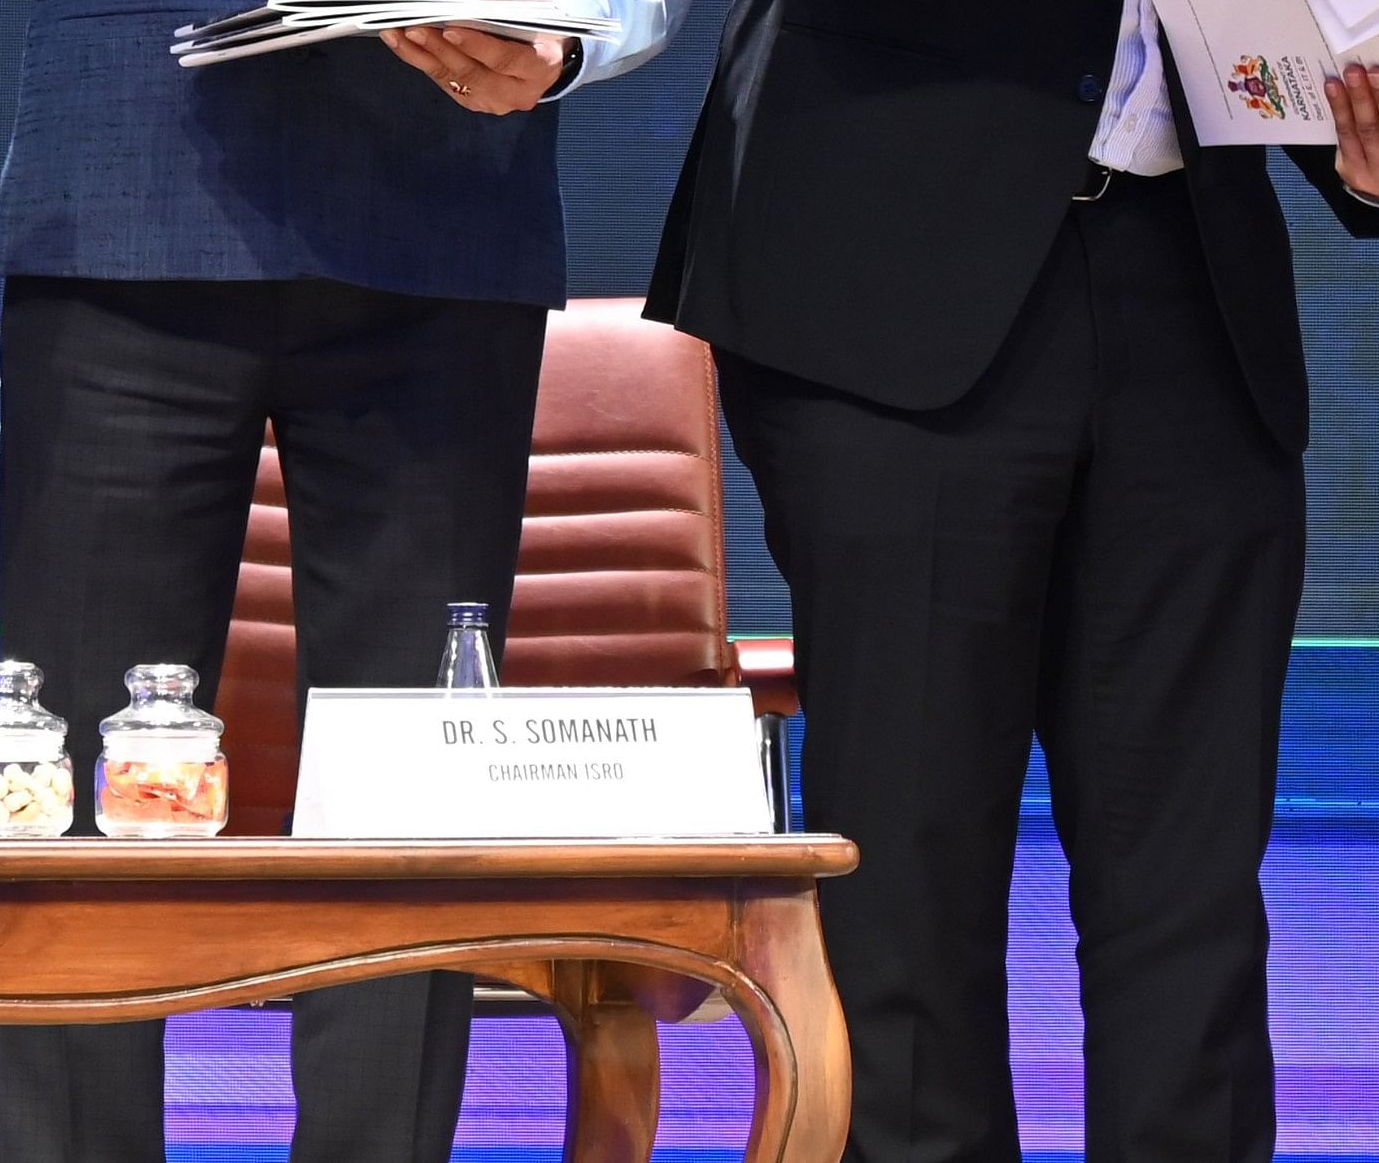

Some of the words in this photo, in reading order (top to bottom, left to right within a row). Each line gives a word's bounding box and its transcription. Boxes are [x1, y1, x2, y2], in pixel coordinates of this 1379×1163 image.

[1281, 56, 1311, 121] KARNATAKA
[442, 720, 484, 745] DR.
[492, 719, 516, 745] S.
[525, 718, 658, 744] SOMANATH
[488, 764, 578, 781] CHAIRMAN
[585, 762, 624, 781] ISRO
